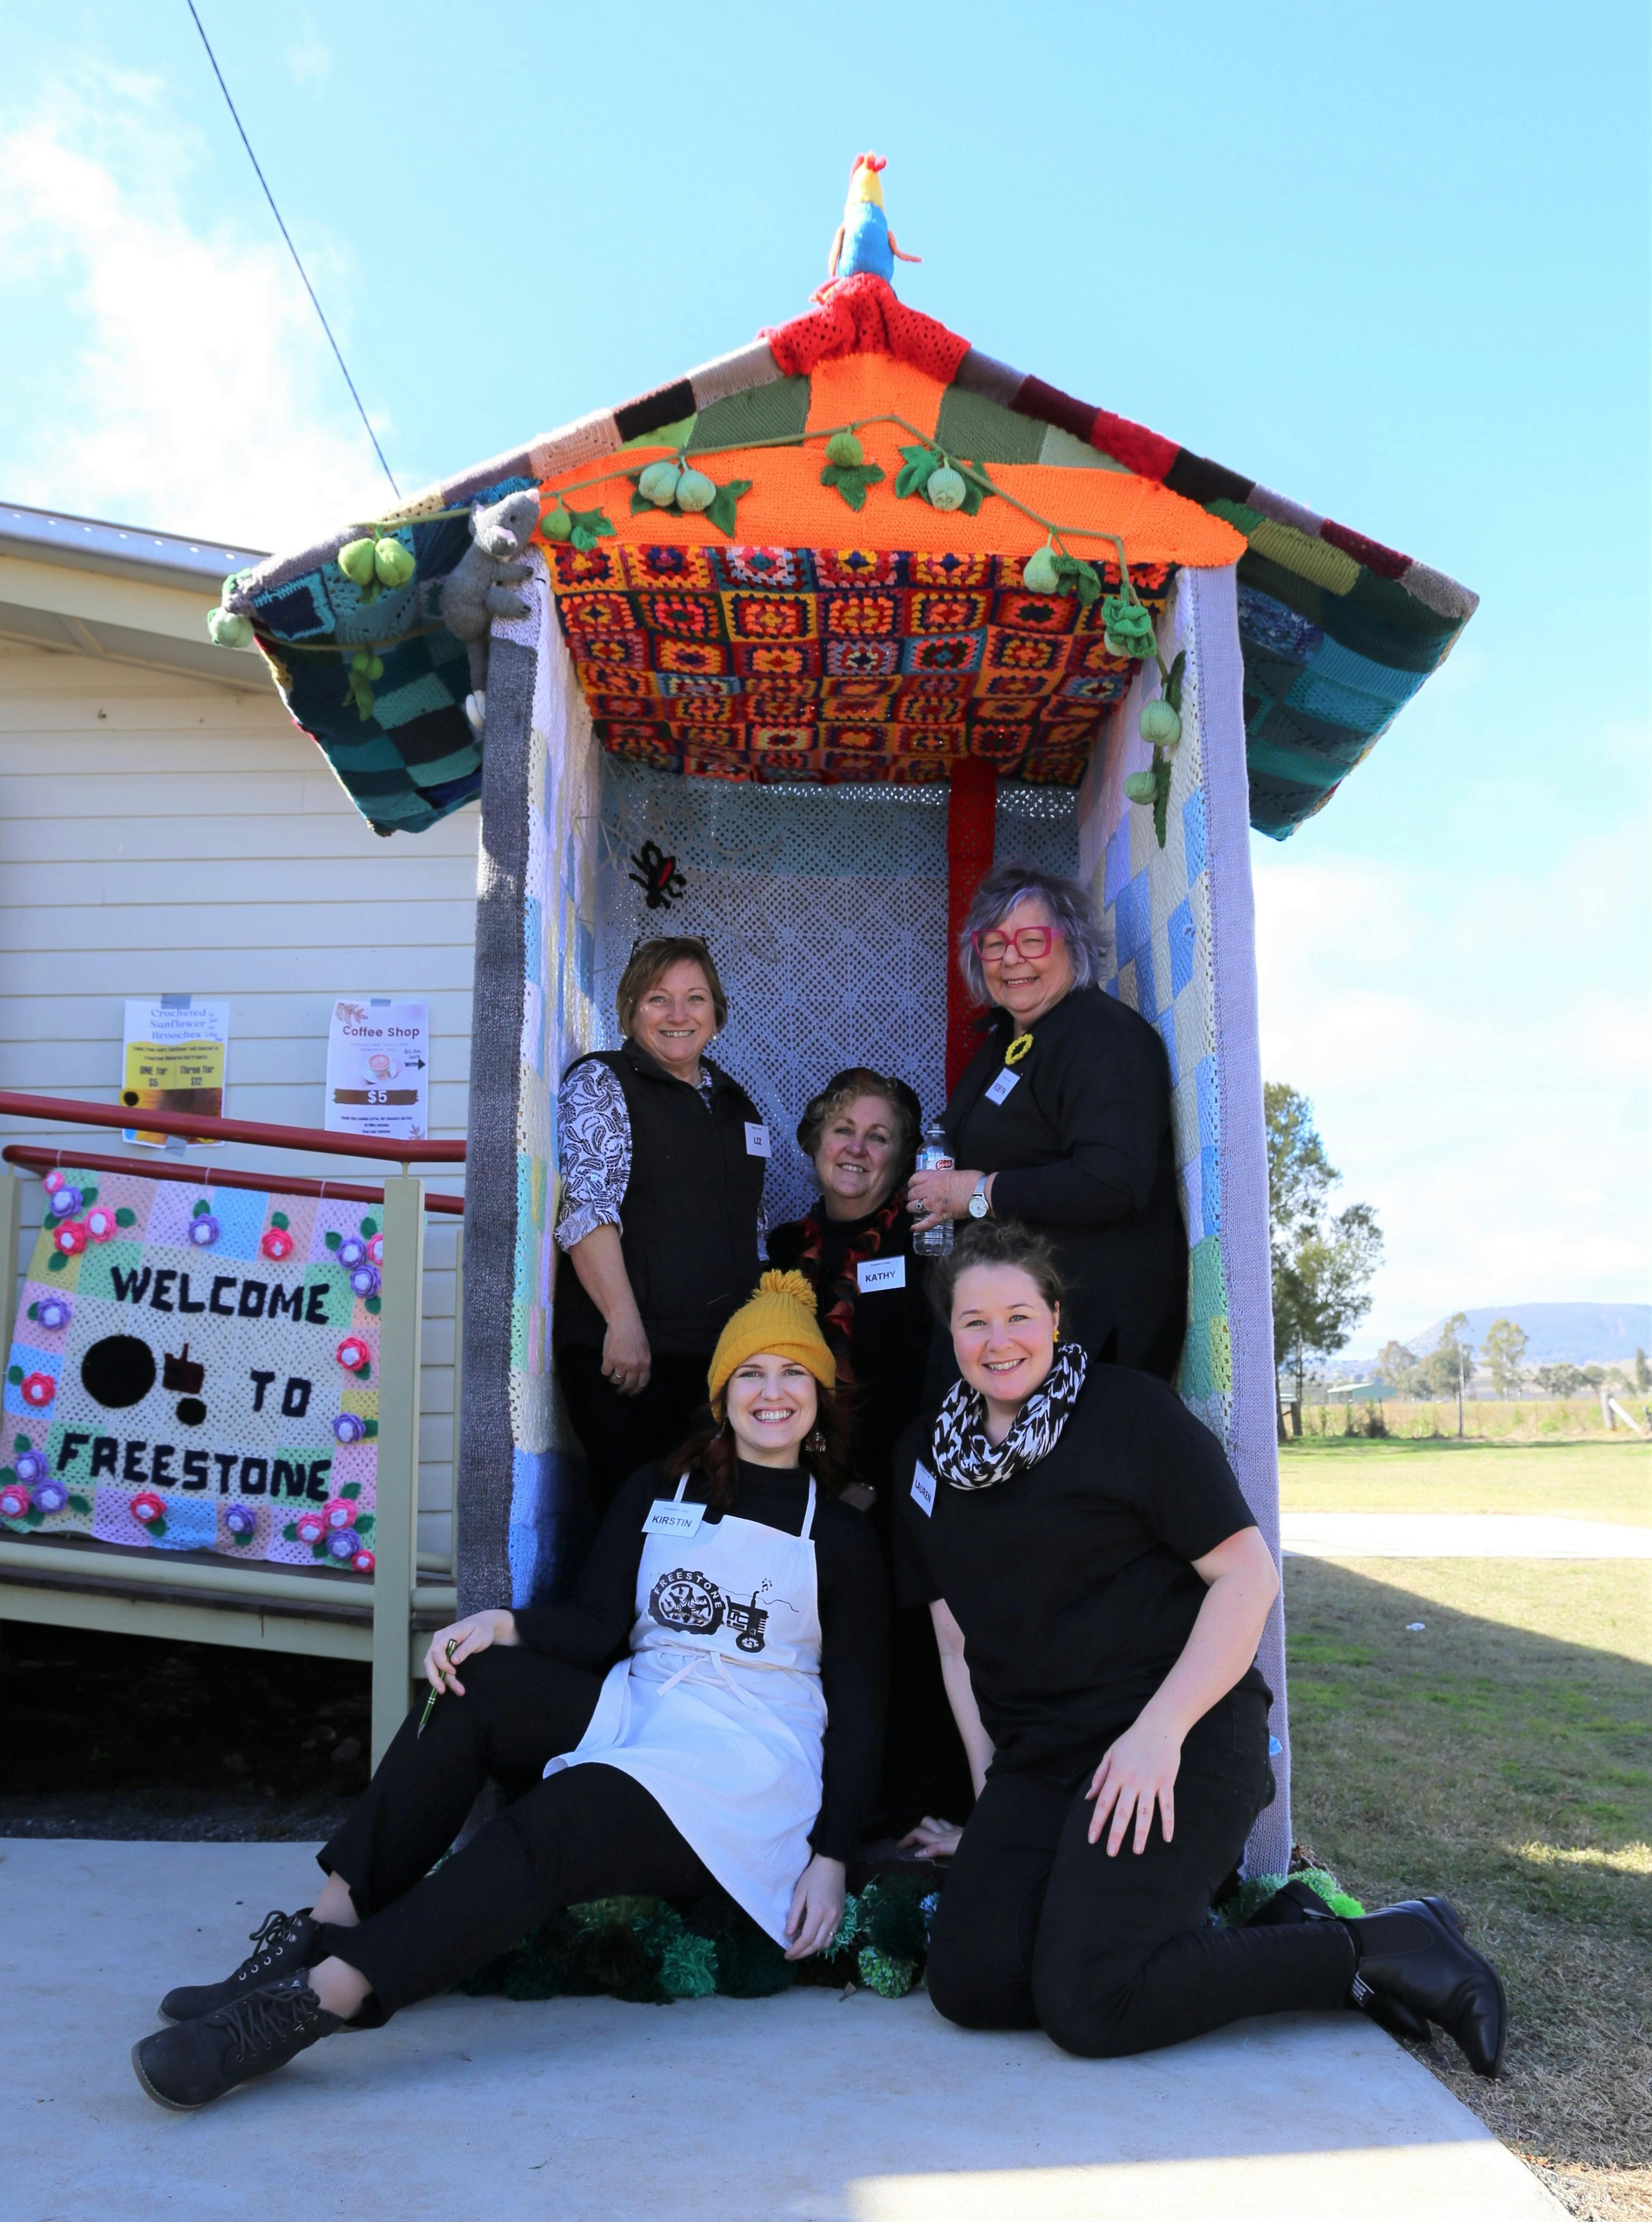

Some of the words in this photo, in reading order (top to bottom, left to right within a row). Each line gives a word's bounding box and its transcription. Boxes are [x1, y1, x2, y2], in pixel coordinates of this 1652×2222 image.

[151, 1008, 206, 1017] Crocheted
[150, 1020, 205, 1028] Sunflower
[152, 1030, 201, 1039] Brooches
[343, 1025, 383, 1037] Coffee
[388, 1026, 420, 1039] Shop
[140, 1066, 153, 1075] ONE
[156, 1066, 167, 1076] for
[180, 1065, 201, 1074] Three
[203, 1065, 214, 1073] for
[149, 1077, 158, 1087] $5
[190, 1077, 202, 1086] $12
[368, 1090, 388, 1104] $5
[753, 1137, 762, 1145] LIZ
[865, 1270, 896, 1282] KATHY
[110, 1265, 331, 1325] WELCOME
[248, 1366, 312, 1418] TO
[56, 1432, 332, 1502] FREESTONE
[915, 1478, 931, 1504] LAUREN
[652, 1515, 692, 1528] KIRSTIN
[654, 1571, 723, 1609] FREESTONE
